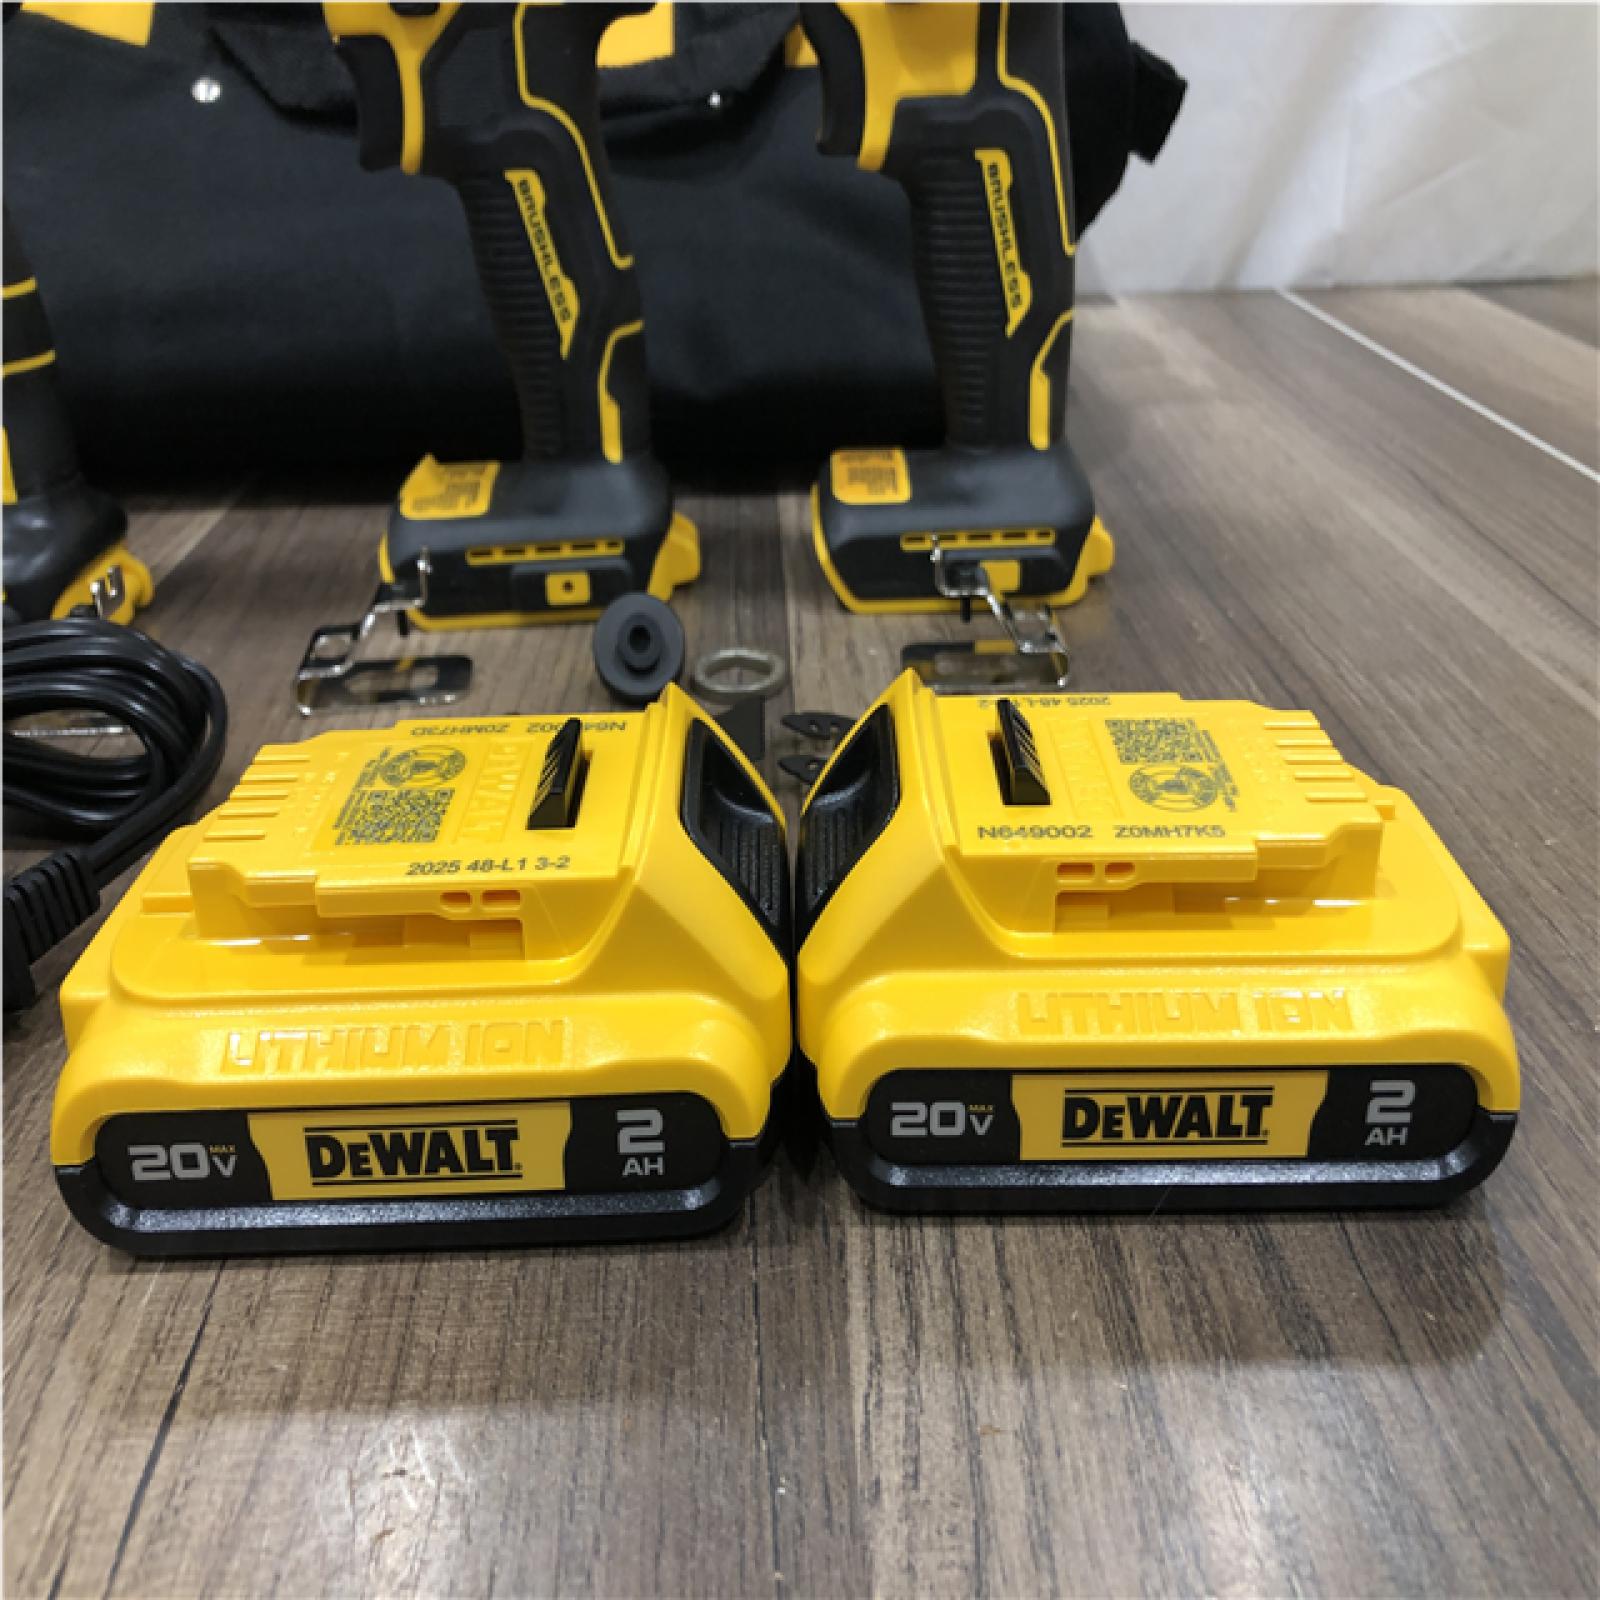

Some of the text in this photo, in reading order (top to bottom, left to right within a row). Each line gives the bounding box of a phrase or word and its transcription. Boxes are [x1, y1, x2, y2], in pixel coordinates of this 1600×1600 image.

[518, 179, 572, 322] BRUSHLESS
[987, 164, 1022, 308] BRUSHLESS
[976, 824, 1094, 839] N649002
[405, 859, 461, 876] 2025
[534, 854, 571, 870] 3-2
[1015, 989, 1355, 1034] LITHIUM ION
[220, 1019, 566, 1074] LITHIUM ION
[1365, 1079, 1415, 1124] 2
[616, 1109, 664, 1154] 2
[1364, 1126, 1408, 1147] AH
[621, 1156, 665, 1177] AH
